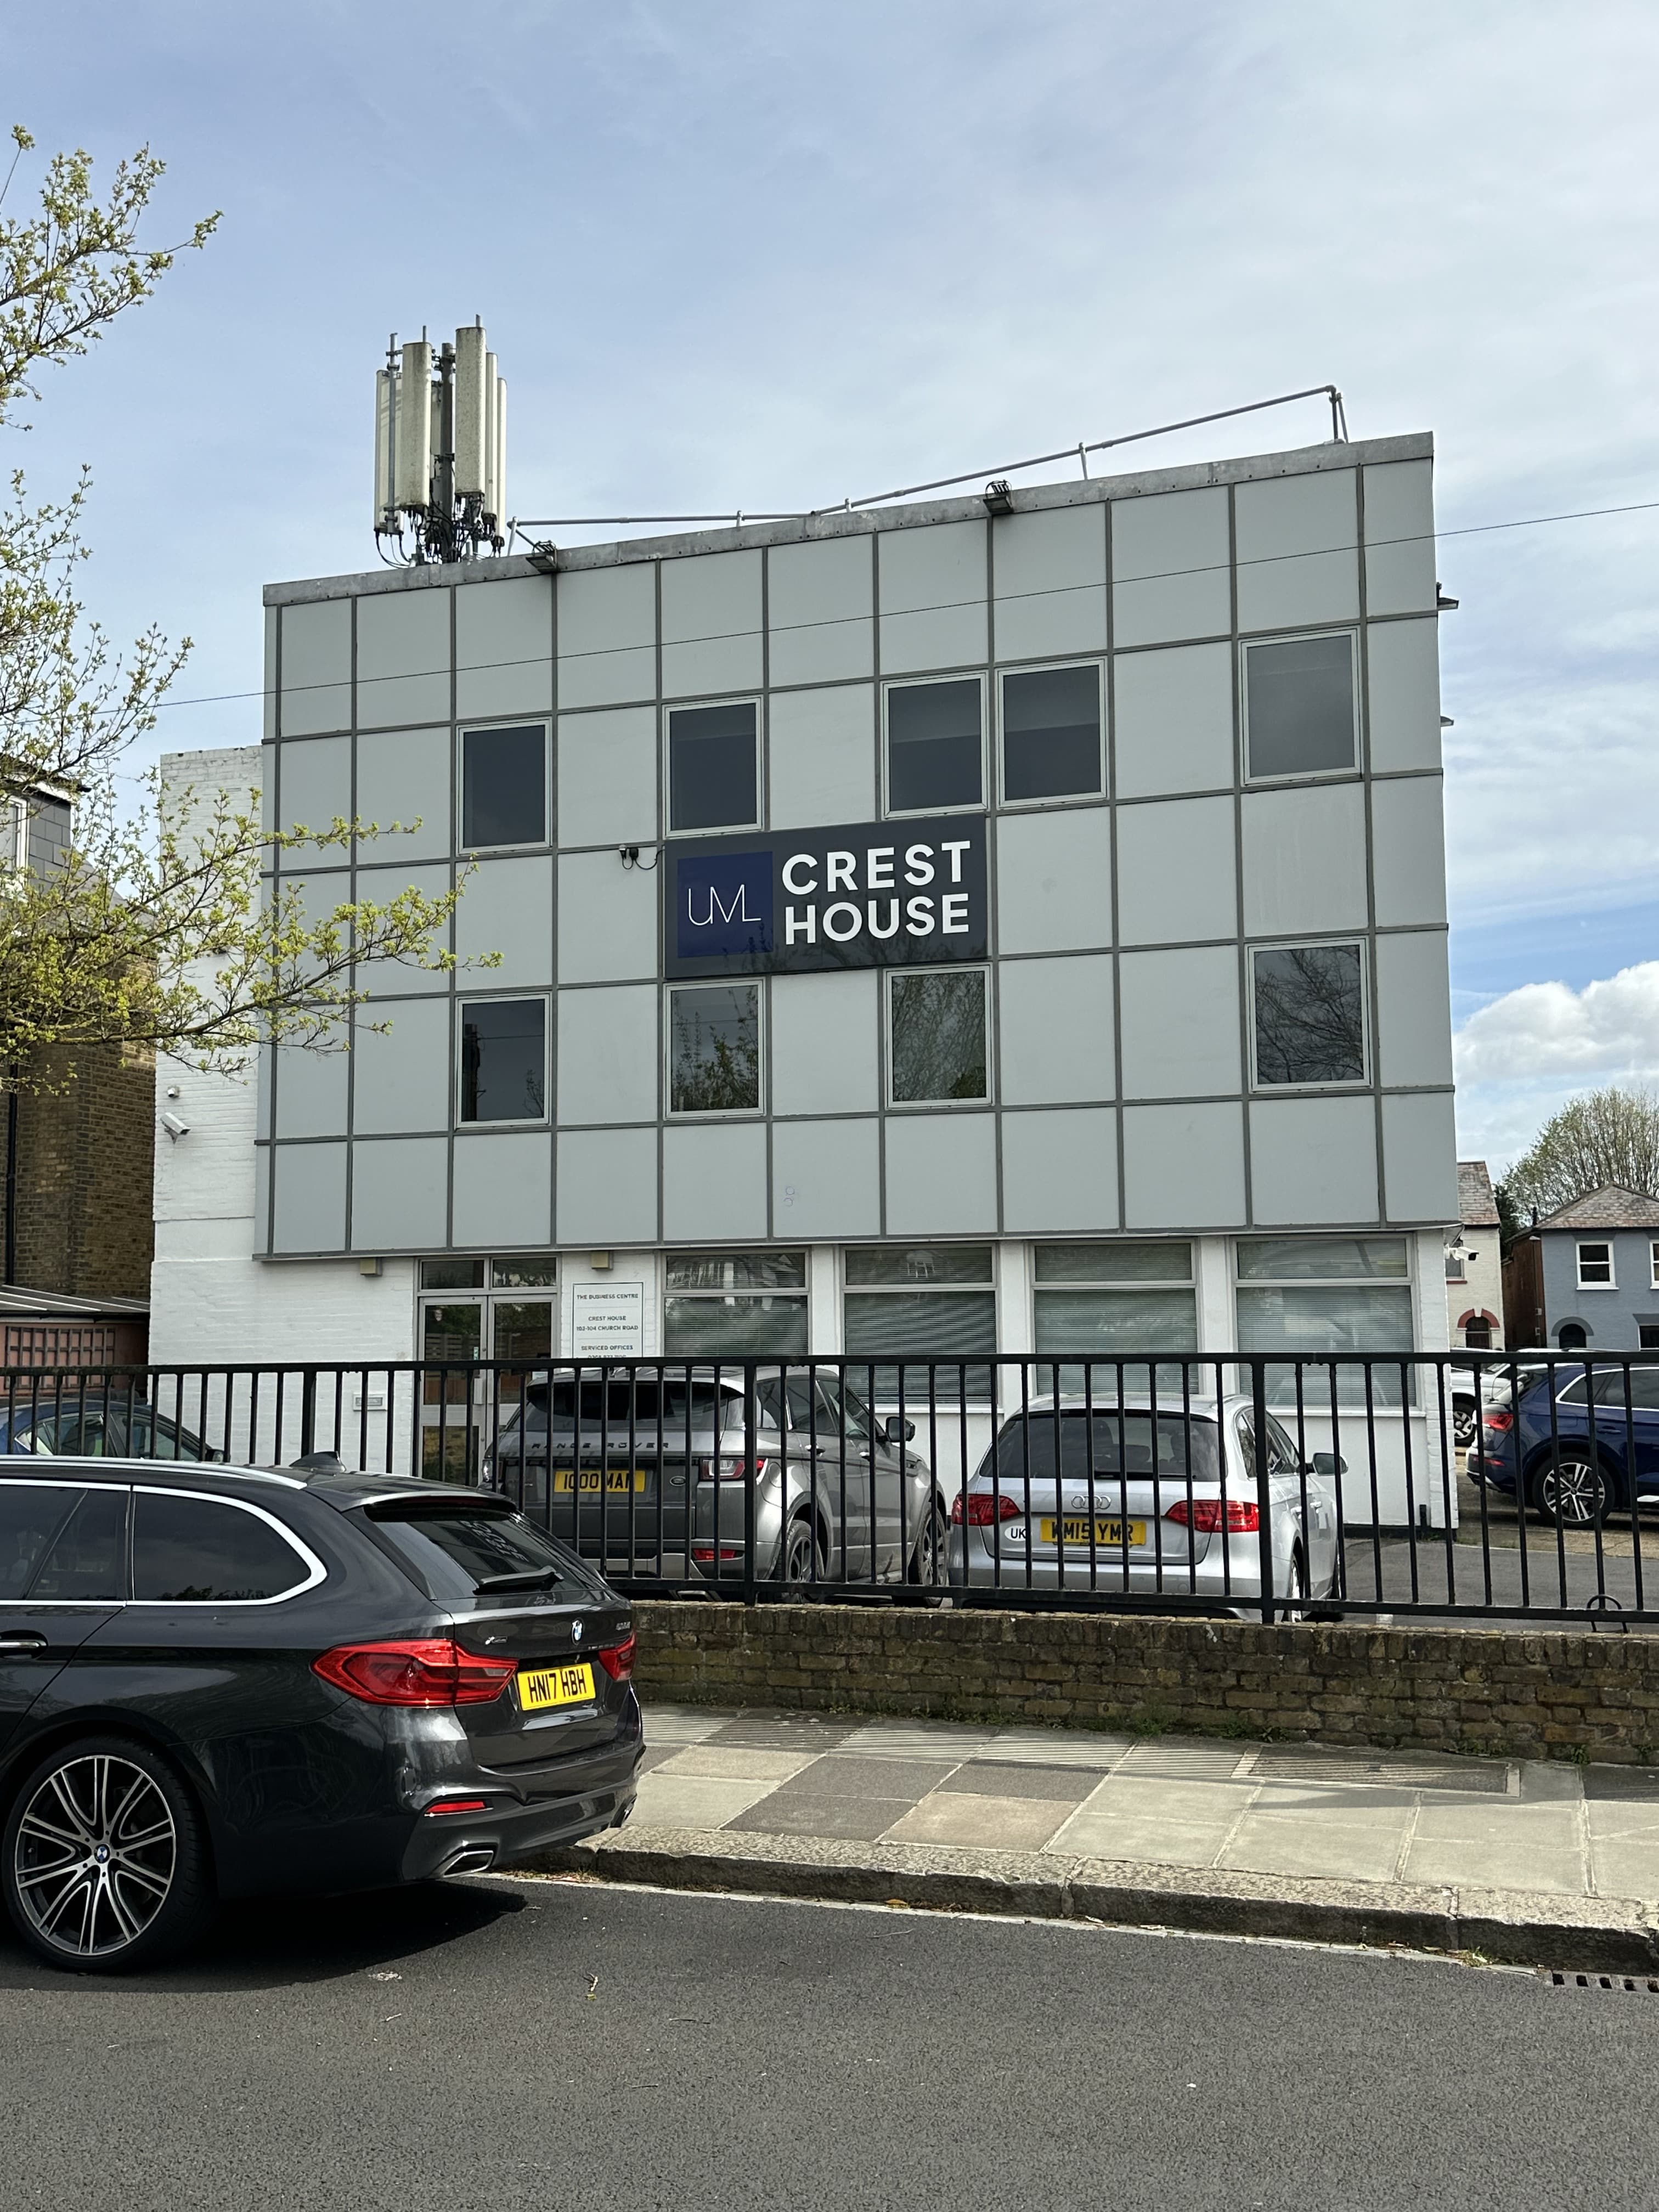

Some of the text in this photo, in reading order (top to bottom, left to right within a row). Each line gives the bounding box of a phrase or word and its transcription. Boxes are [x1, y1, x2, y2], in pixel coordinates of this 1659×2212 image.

[781, 840, 970, 895] CREST
[688, 883, 761, 926] UML
[785, 893, 969, 945] HOUSE
[1011, 1527, 1026, 1539] UK
[1098, 1522, 1133, 1541] YMR
[527, 1668, 587, 1703] HN17 HBH
